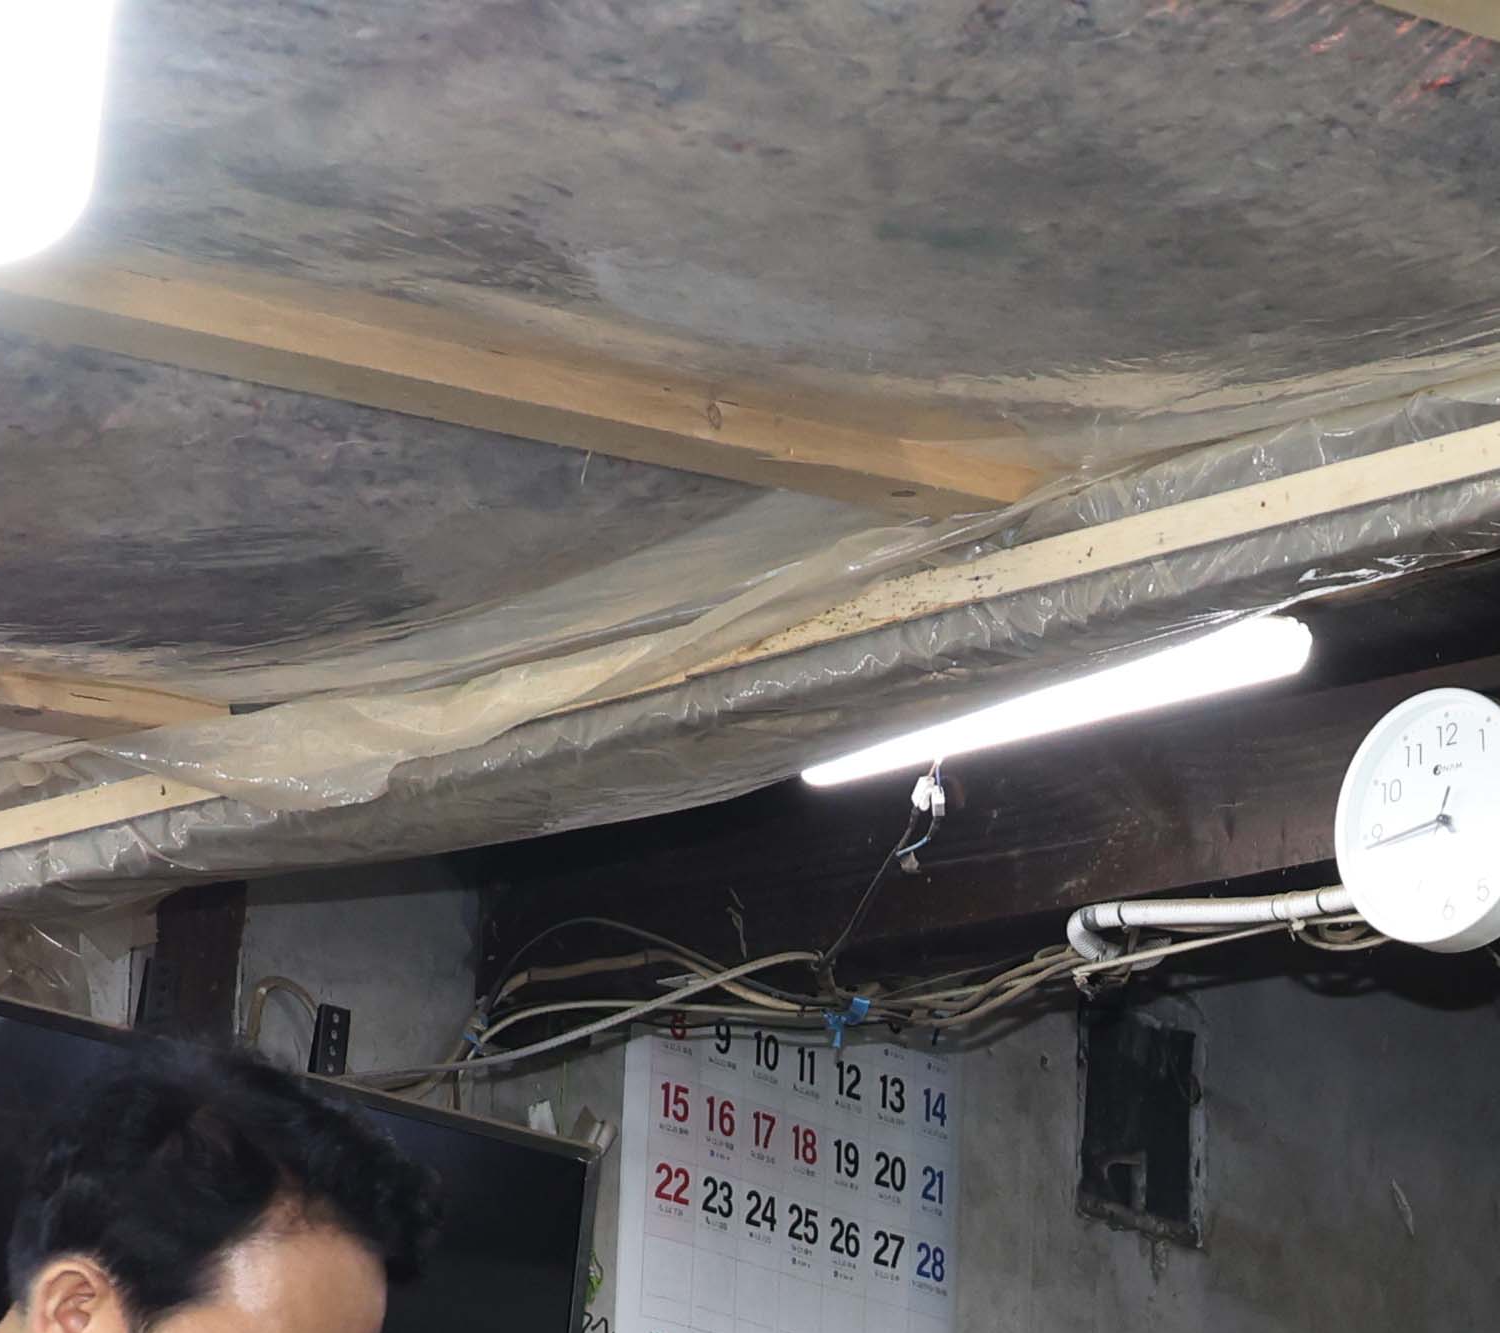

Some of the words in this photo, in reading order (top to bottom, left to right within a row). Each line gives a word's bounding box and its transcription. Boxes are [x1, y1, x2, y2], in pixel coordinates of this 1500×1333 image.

[1381, 779, 1402, 805] 10
[1405, 744, 1423, 768] 11
[1436, 722, 1458, 748] 12
[1479, 728, 1486, 752] 1
[715, 1018, 731, 1054] 9
[754, 1030, 779, 1071] 10
[797, 1047, 816, 1086] 11
[836, 1060, 861, 1101] 12
[879, 1074, 906, 1114] 13
[923, 1087, 947, 1127] 14
[661, 1081, 690, 1123] 15
[706, 1095, 735, 1137] 16
[753, 1110, 776, 1149] 17
[792, 1124, 818, 1165] 18
[834, 1138, 860, 1179] 19
[874, 1151, 906, 1192] 20
[921, 1165, 944, 1205] 21
[655, 1162, 690, 1206] 22
[702, 1176, 733, 1218] 23
[745, 1190, 777, 1233] 24
[787, 1203, 819, 1245] 25
[829, 1217, 861, 1258] 26
[873, 1230, 905, 1270] 27
[916, 1242, 945, 1283] 28
